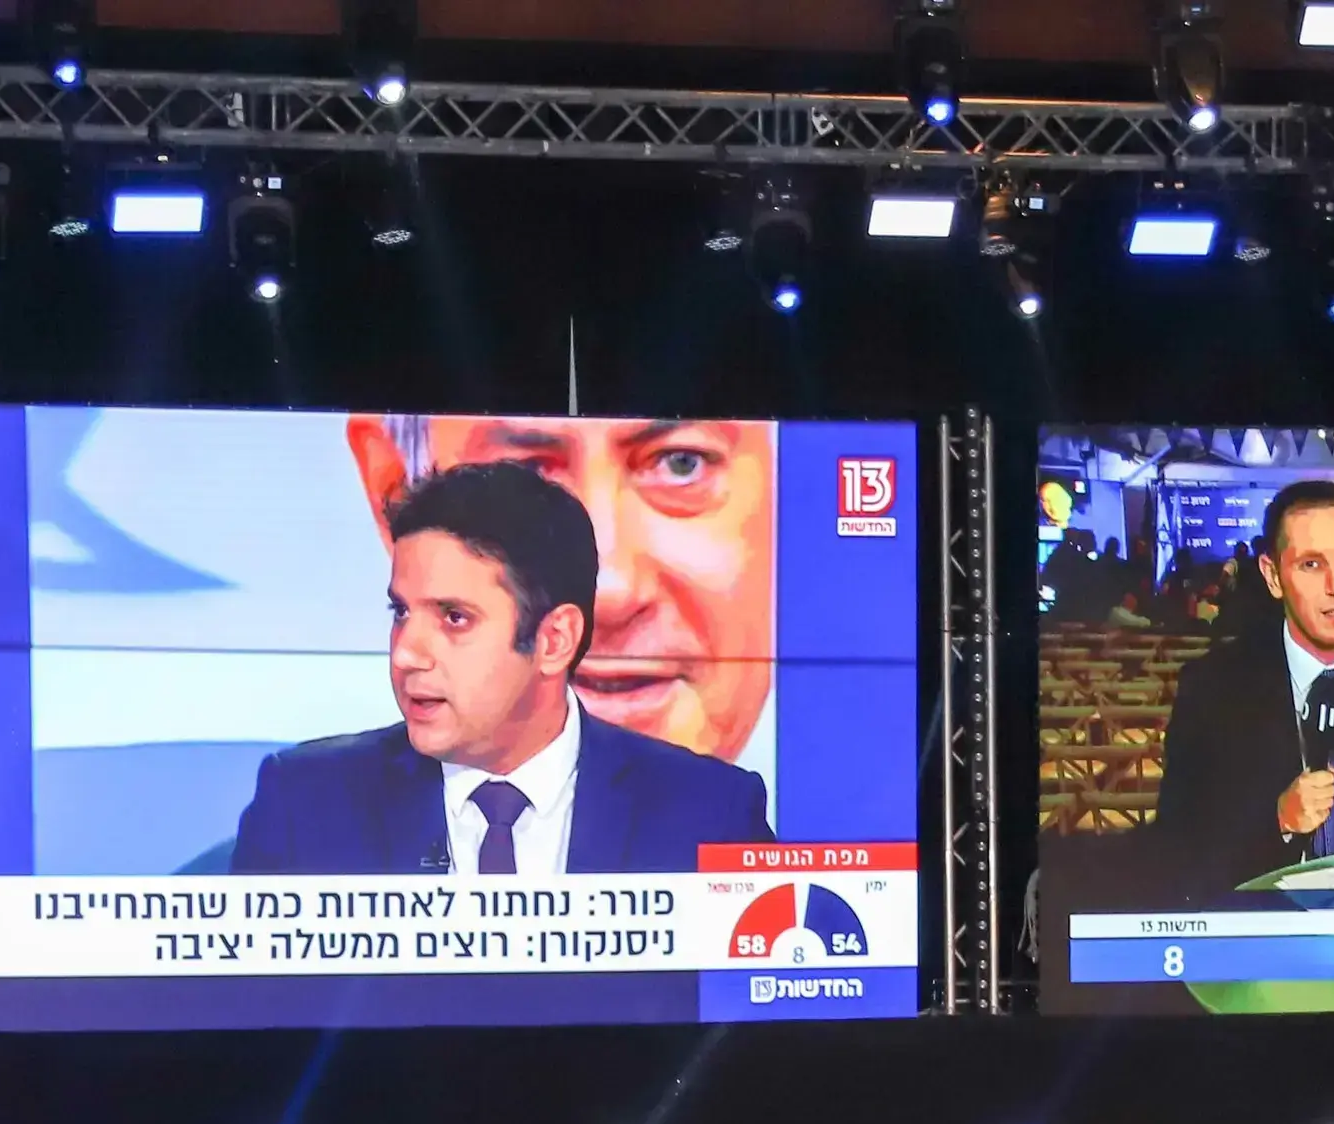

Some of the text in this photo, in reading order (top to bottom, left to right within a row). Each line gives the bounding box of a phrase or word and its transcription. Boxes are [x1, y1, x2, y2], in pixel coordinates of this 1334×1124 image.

[841, 460, 892, 512] 13
[841, 521, 893, 533] החדשות
[742, 849, 869, 867] מפת הגושים
[865, 880, 887, 893] ימין
[34, 887, 675, 920] פורר: נחתור לאחדות כמו שהתחייבנו
[1141, 919, 1208, 933] חדשות 13
[155, 929, 675, 962] ניסנקורן: רוצים ממשלה יציבה
[737, 934, 767, 955] 58
[831, 933, 862, 954] 54
[792, 946, 805, 964] 8
[1163, 945, 1184, 977] 8
[777, 977, 863, 1000] החדשות
